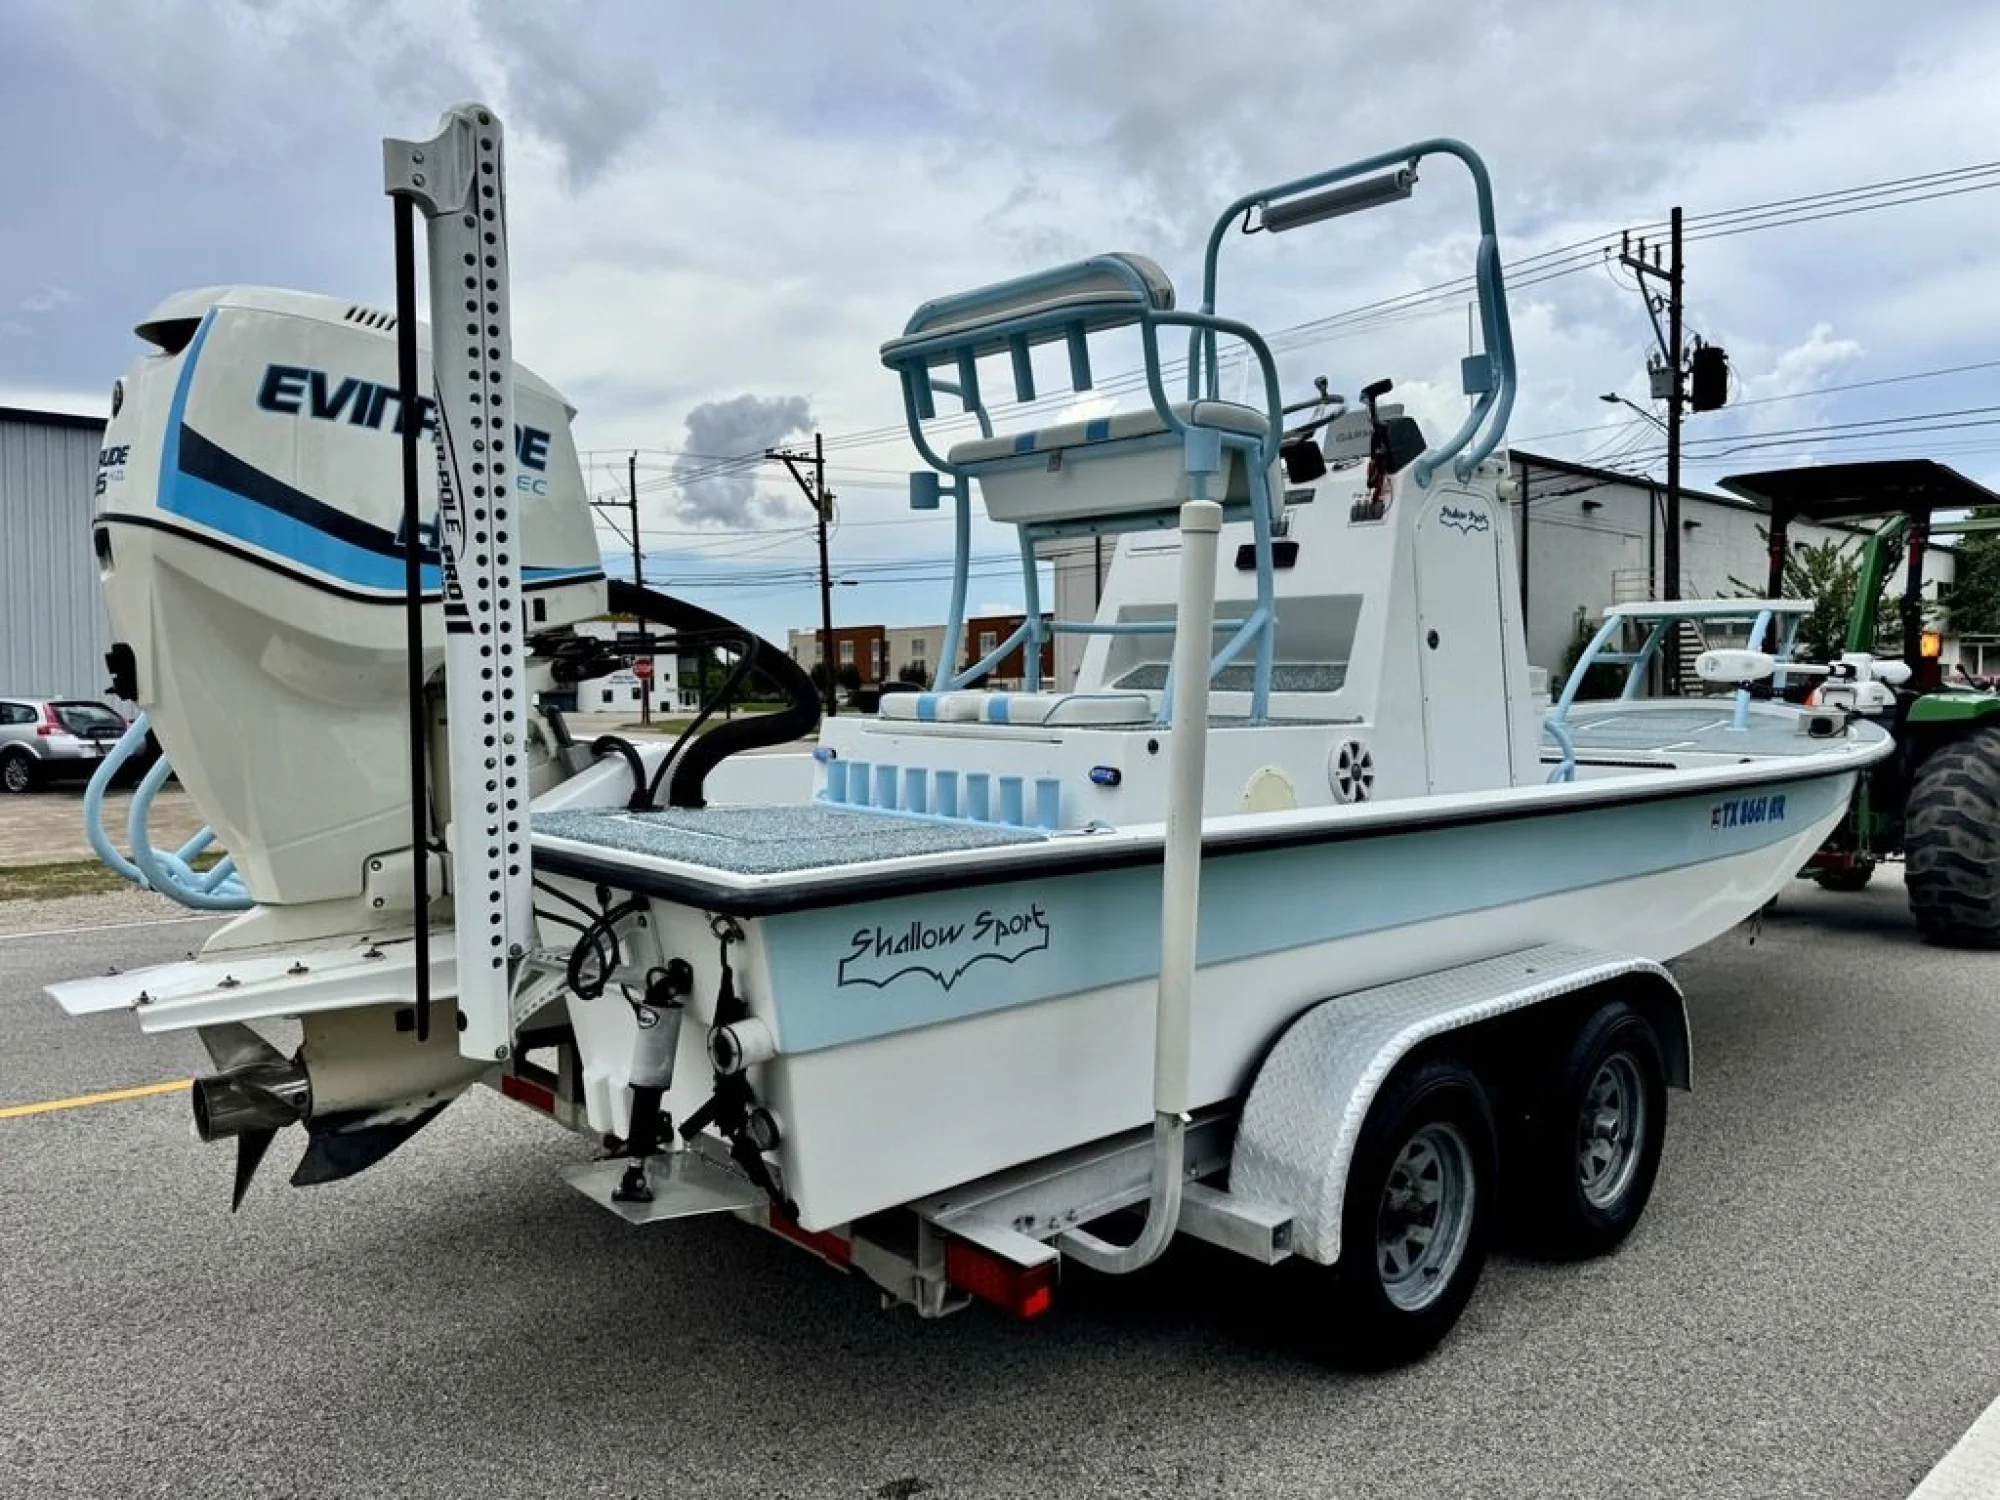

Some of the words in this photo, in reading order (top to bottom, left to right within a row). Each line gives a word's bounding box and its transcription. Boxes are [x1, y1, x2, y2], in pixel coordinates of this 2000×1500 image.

[1722, 802, 1739, 828] TX
[850, 921, 966, 960] Shallow
[972, 903, 1048, 947] Sport
